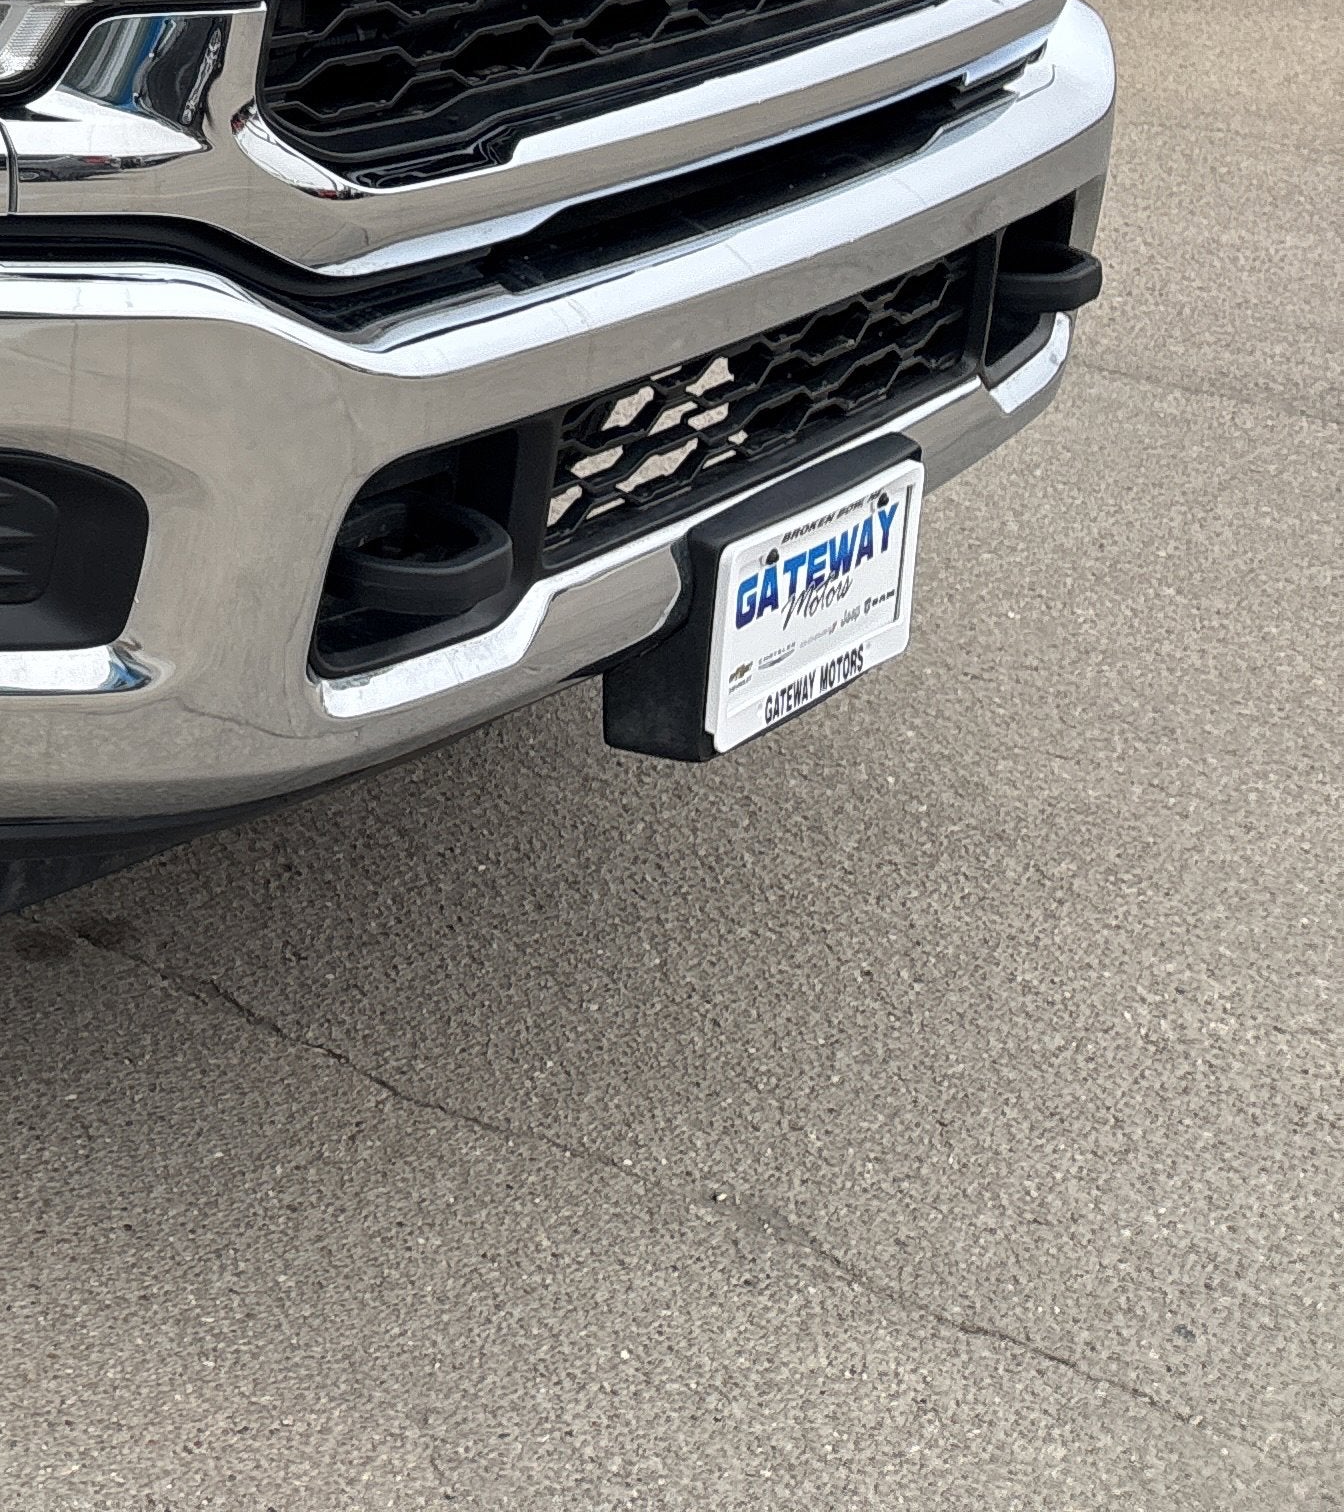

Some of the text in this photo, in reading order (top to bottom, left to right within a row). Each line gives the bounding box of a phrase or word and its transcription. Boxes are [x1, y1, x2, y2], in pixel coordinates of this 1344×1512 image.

[735, 501, 900, 631] GATEWAY
[781, 571, 854, 631] Motors
[765, 642, 864, 725] GATEWAY MOTORS
